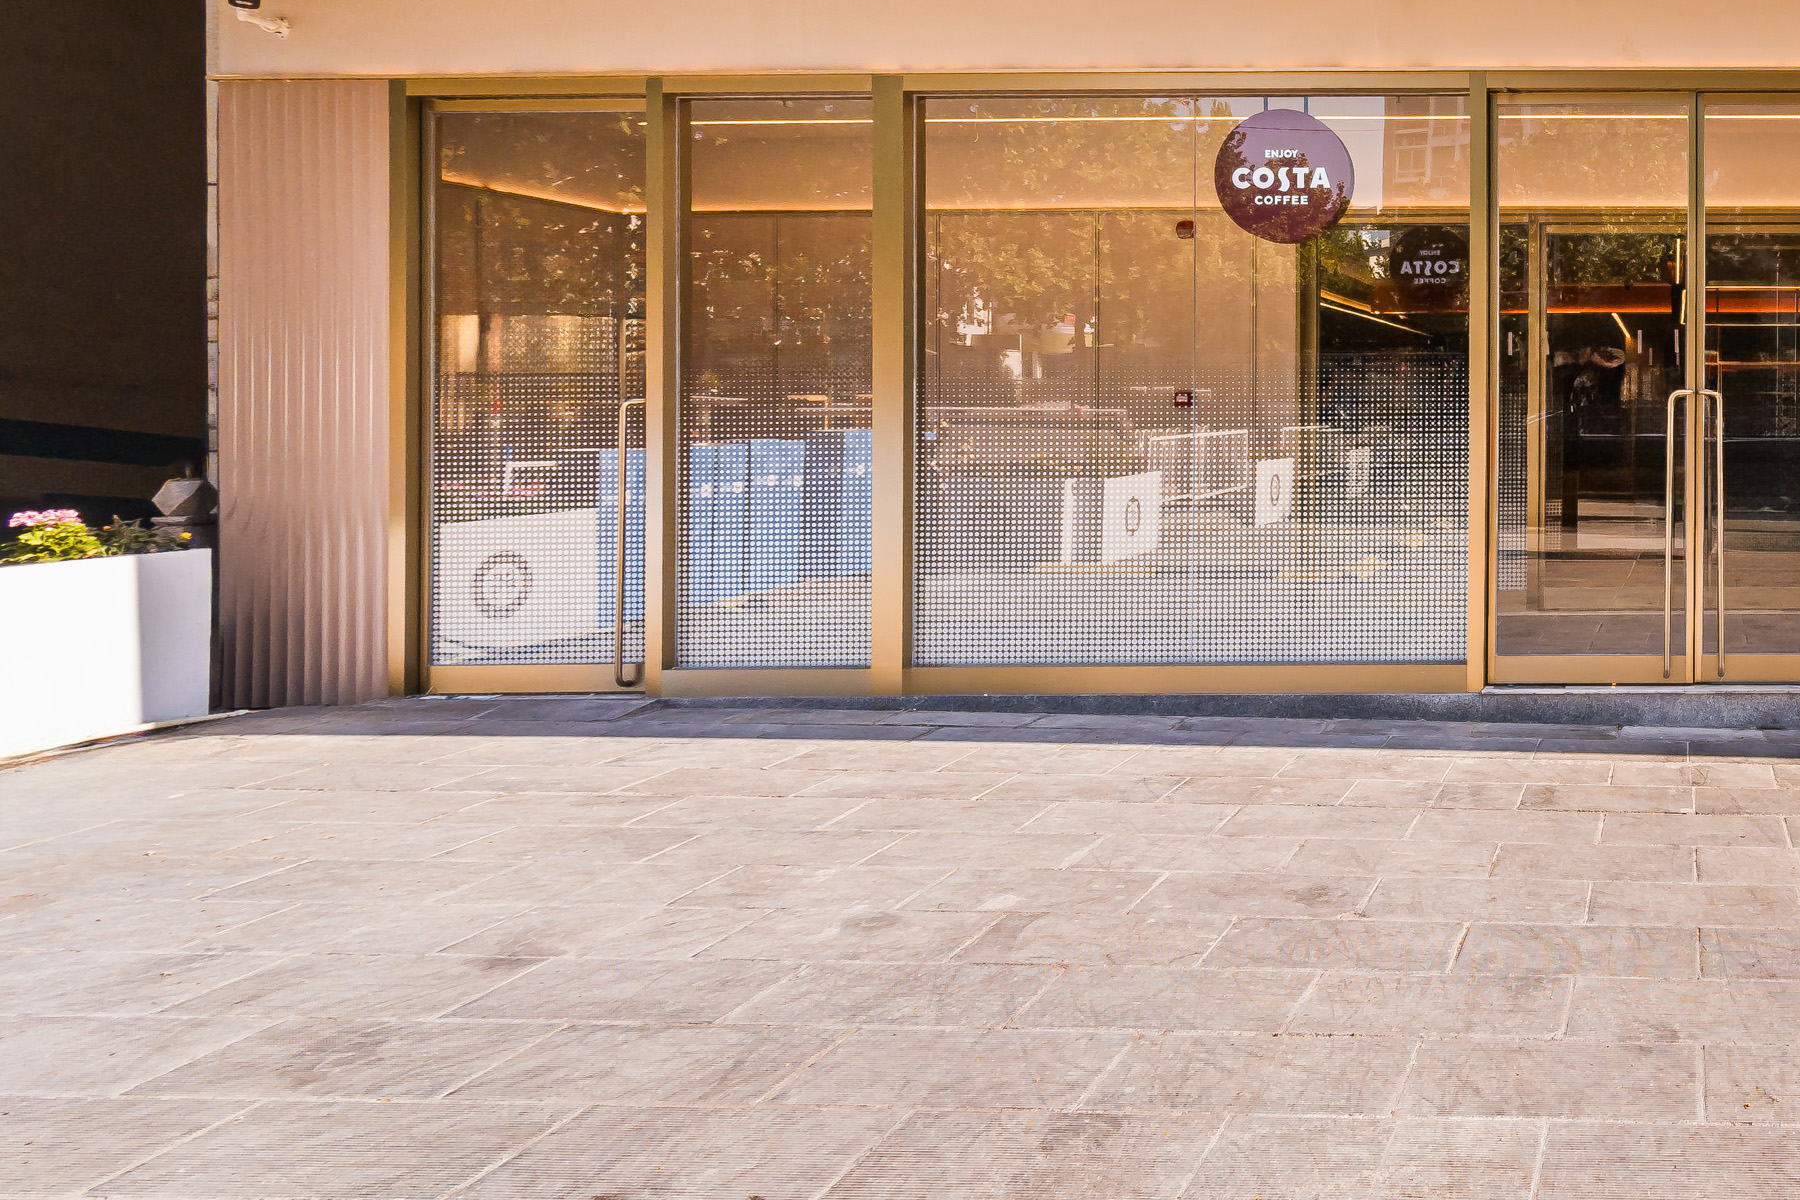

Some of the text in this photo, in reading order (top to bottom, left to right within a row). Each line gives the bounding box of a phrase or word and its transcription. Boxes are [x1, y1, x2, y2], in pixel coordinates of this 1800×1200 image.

[1264, 149, 1299, 159] ENJOY
[1231, 166, 1331, 193] COSTA
[1254, 195, 1309, 206] COFFEE
